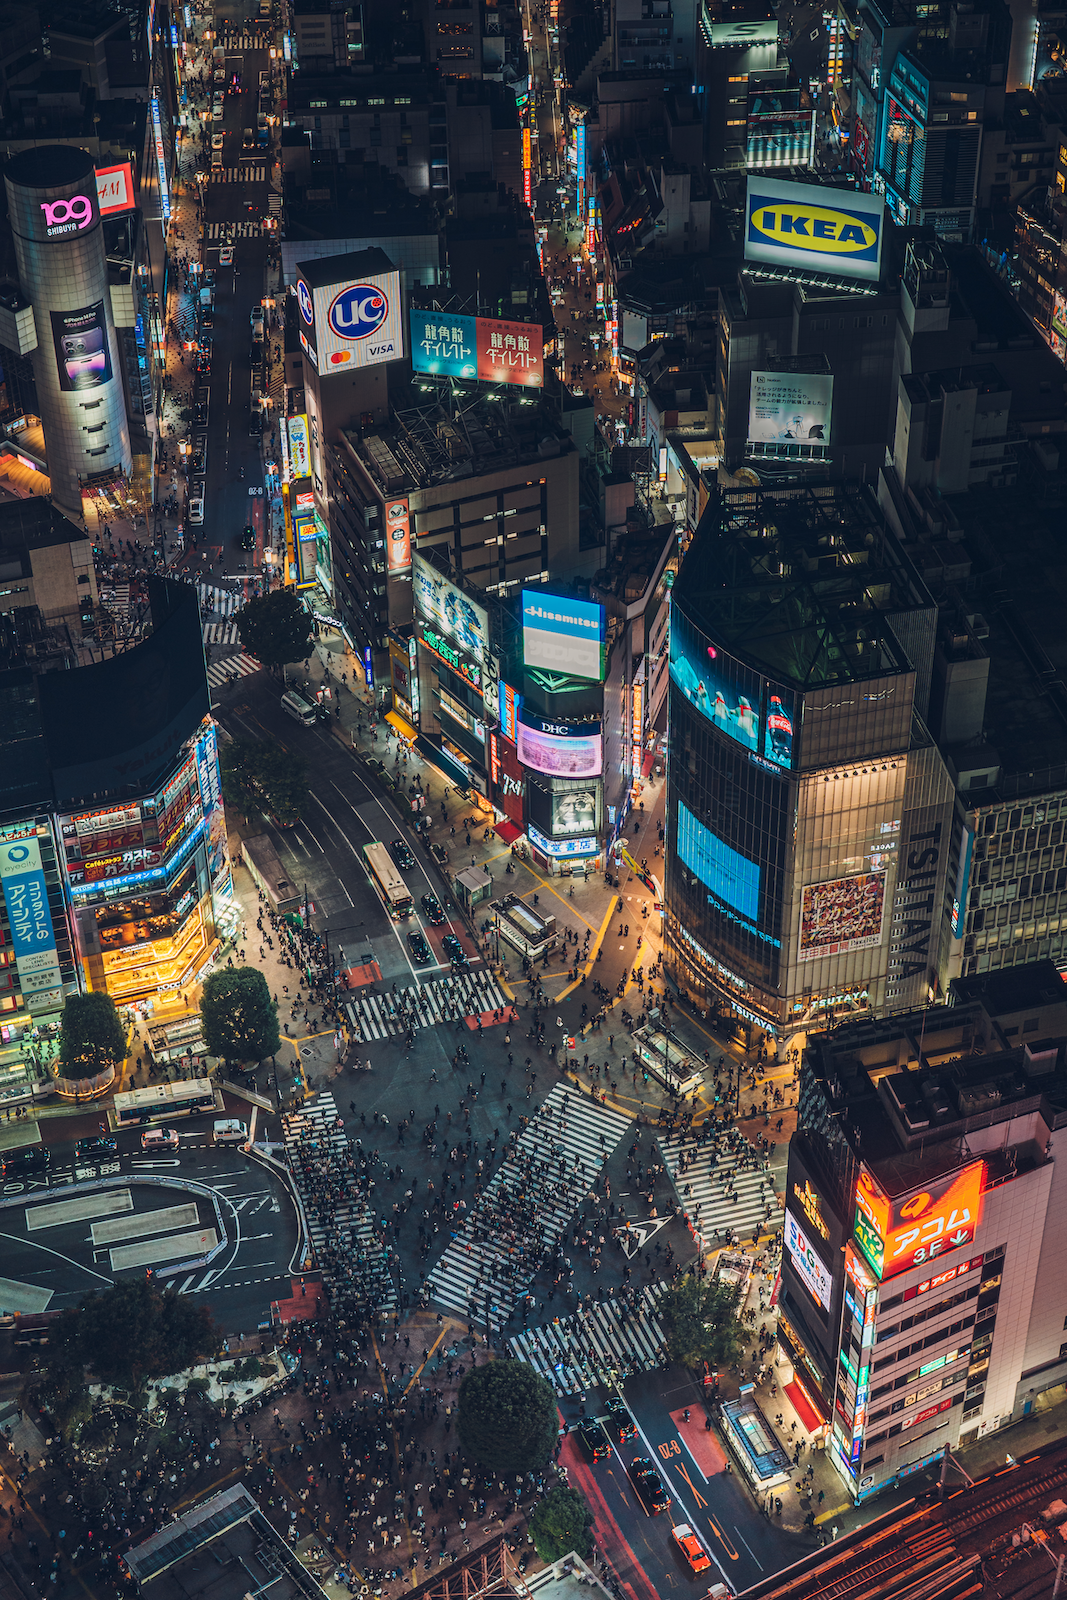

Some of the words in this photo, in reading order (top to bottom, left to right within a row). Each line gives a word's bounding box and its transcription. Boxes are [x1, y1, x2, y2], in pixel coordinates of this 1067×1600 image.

[40, 195, 92, 230] 109
[47, 222, 77, 237] SHIBUYA
[762, 211, 868, 245] IKEA
[68, 315, 83, 323] iPhone
[424, 324, 463, 343] 龍角散
[490, 332, 530, 351] 龍角散
[369, 344, 394, 355] VISA
[420, 340, 471, 359] ダイレクト
[486, 348, 537, 368] ダイレクト
[249, 487, 263, 496] 8-20
[524, 605, 599, 628] Hisamitsu
[541, 722, 569, 735] DHC
[113, 729, 181, 776] Yakult
[63, 825, 75, 834] 9F
[123, 849, 156, 862] ガスト
[4, 861, 37, 872] eyecity
[105, 860, 141, 876] ガスト
[70, 872, 84, 882] 7F
[97, 872, 150, 889] 英会話イーオン
[28, 881, 49, 940] コンタクトの
[899, 822, 942, 980] TSUTAYA
[8, 884, 34, 942] アイシティ
[811, 990, 869, 1008] TSUTAYA
[730, 1001, 775, 1033] TSUTAYA
[855, 1189, 882, 1235] アコム
[857, 1209, 884, 1251] レイク
[893, 1208, 970, 1256] アコム
[913, 1238, 943, 1264] 3F
[932, 1264, 968, 1287] アイフル
[918, 1407, 938, 1421] アコム
[658, 1440, 681, 1459] 8-20
